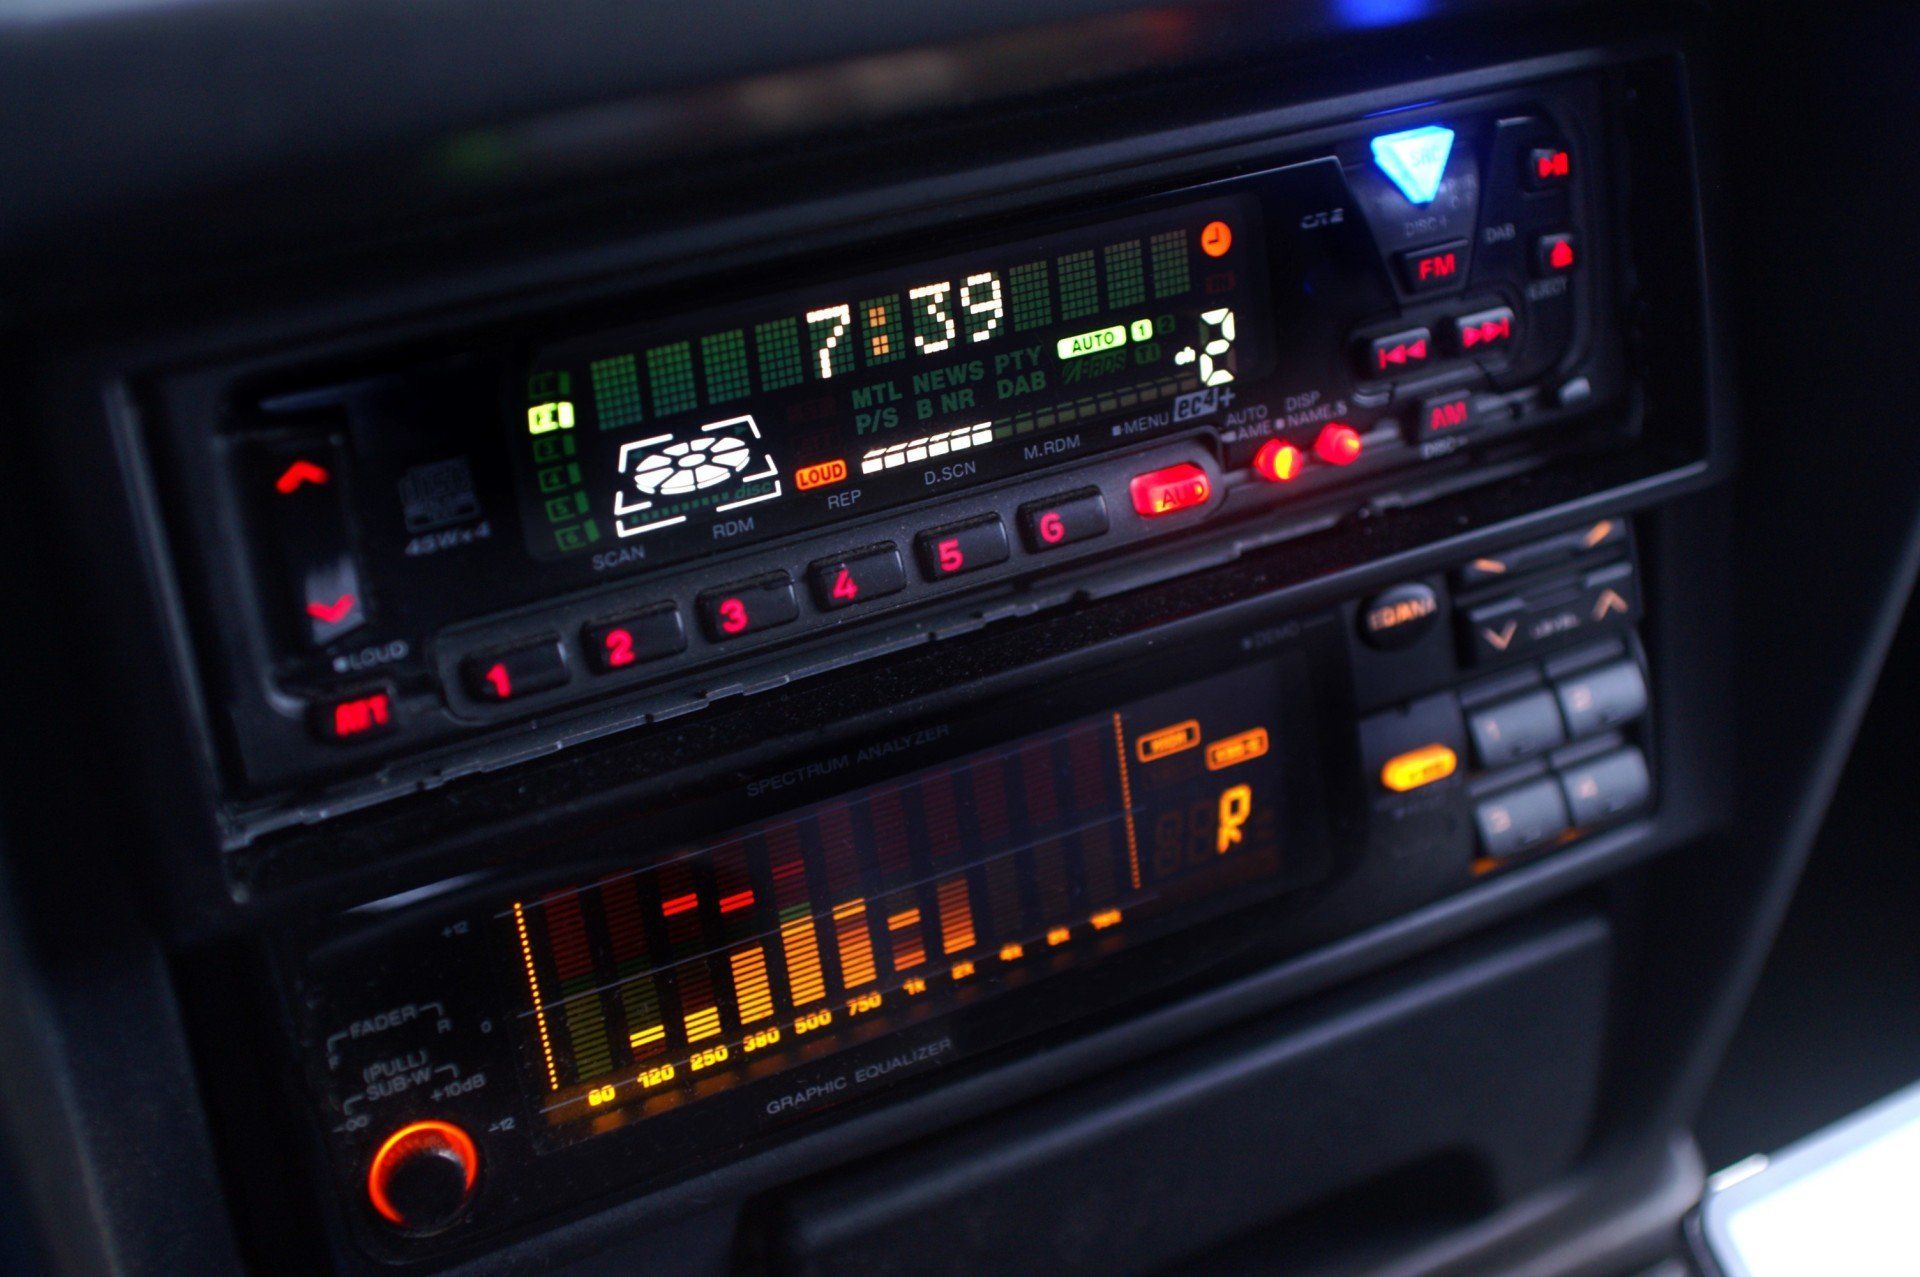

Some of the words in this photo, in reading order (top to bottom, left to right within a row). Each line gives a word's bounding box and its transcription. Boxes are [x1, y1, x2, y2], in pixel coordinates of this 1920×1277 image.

[1418, 252, 1456, 282] FM
[806, 272, 1004, 380] 7:39
[1072, 332, 1115, 353] AUTO
[851, 379, 902, 411] MTL
[913, 361, 986, 395] NEWS
[995, 345, 1043, 376] PTY
[855, 406, 900, 436] P/S
[917, 396, 933, 421] B
[942, 388, 976, 416] NR
[998, 371, 1048, 401] DAB
[1226, 403, 1268, 427] AUTO
[1284, 390, 1321, 413] DISP
[1430, 402, 1468, 432] AM
[1123, 411, 1170, 434] MENU
[1023, 434, 1081, 462] M.RDM
[734, 479, 772, 501] disc
[800, 464, 842, 487] LOUD
[924, 460, 977, 487] D.SCN
[827, 489, 862, 510] REP
[711, 516, 755, 540] RDM
[592, 545, 646, 571] SCAN
[938, 539, 964, 573] 5
[831, 568, 859, 602] 4
[720, 597, 748, 633] 3
[349, 639, 409, 673] LOUD
[604, 627, 637, 668] 2
[485, 662, 512, 699] 1
[746, 754, 850, 798] SPECTRUM
[855, 724, 950, 765] ANALYZER
[1217, 783, 1252, 854] R
[350, 1004, 417, 1038] FADER
[437, 1018, 451, 1034] R
[636, 1063, 675, 1089] 120
[689, 1044, 729, 1072] 250
[793, 1009, 833, 1035] 500
[846, 992, 883, 1018] 750
[363, 1050, 428, 1083] (PULL)
[766, 1075, 848, 1116] GRAPHIC
[853, 1036, 953, 1085] EQUALIZER
[366, 1067, 432, 1102] SUB-W
[430, 1073, 487, 1102] +10dB
